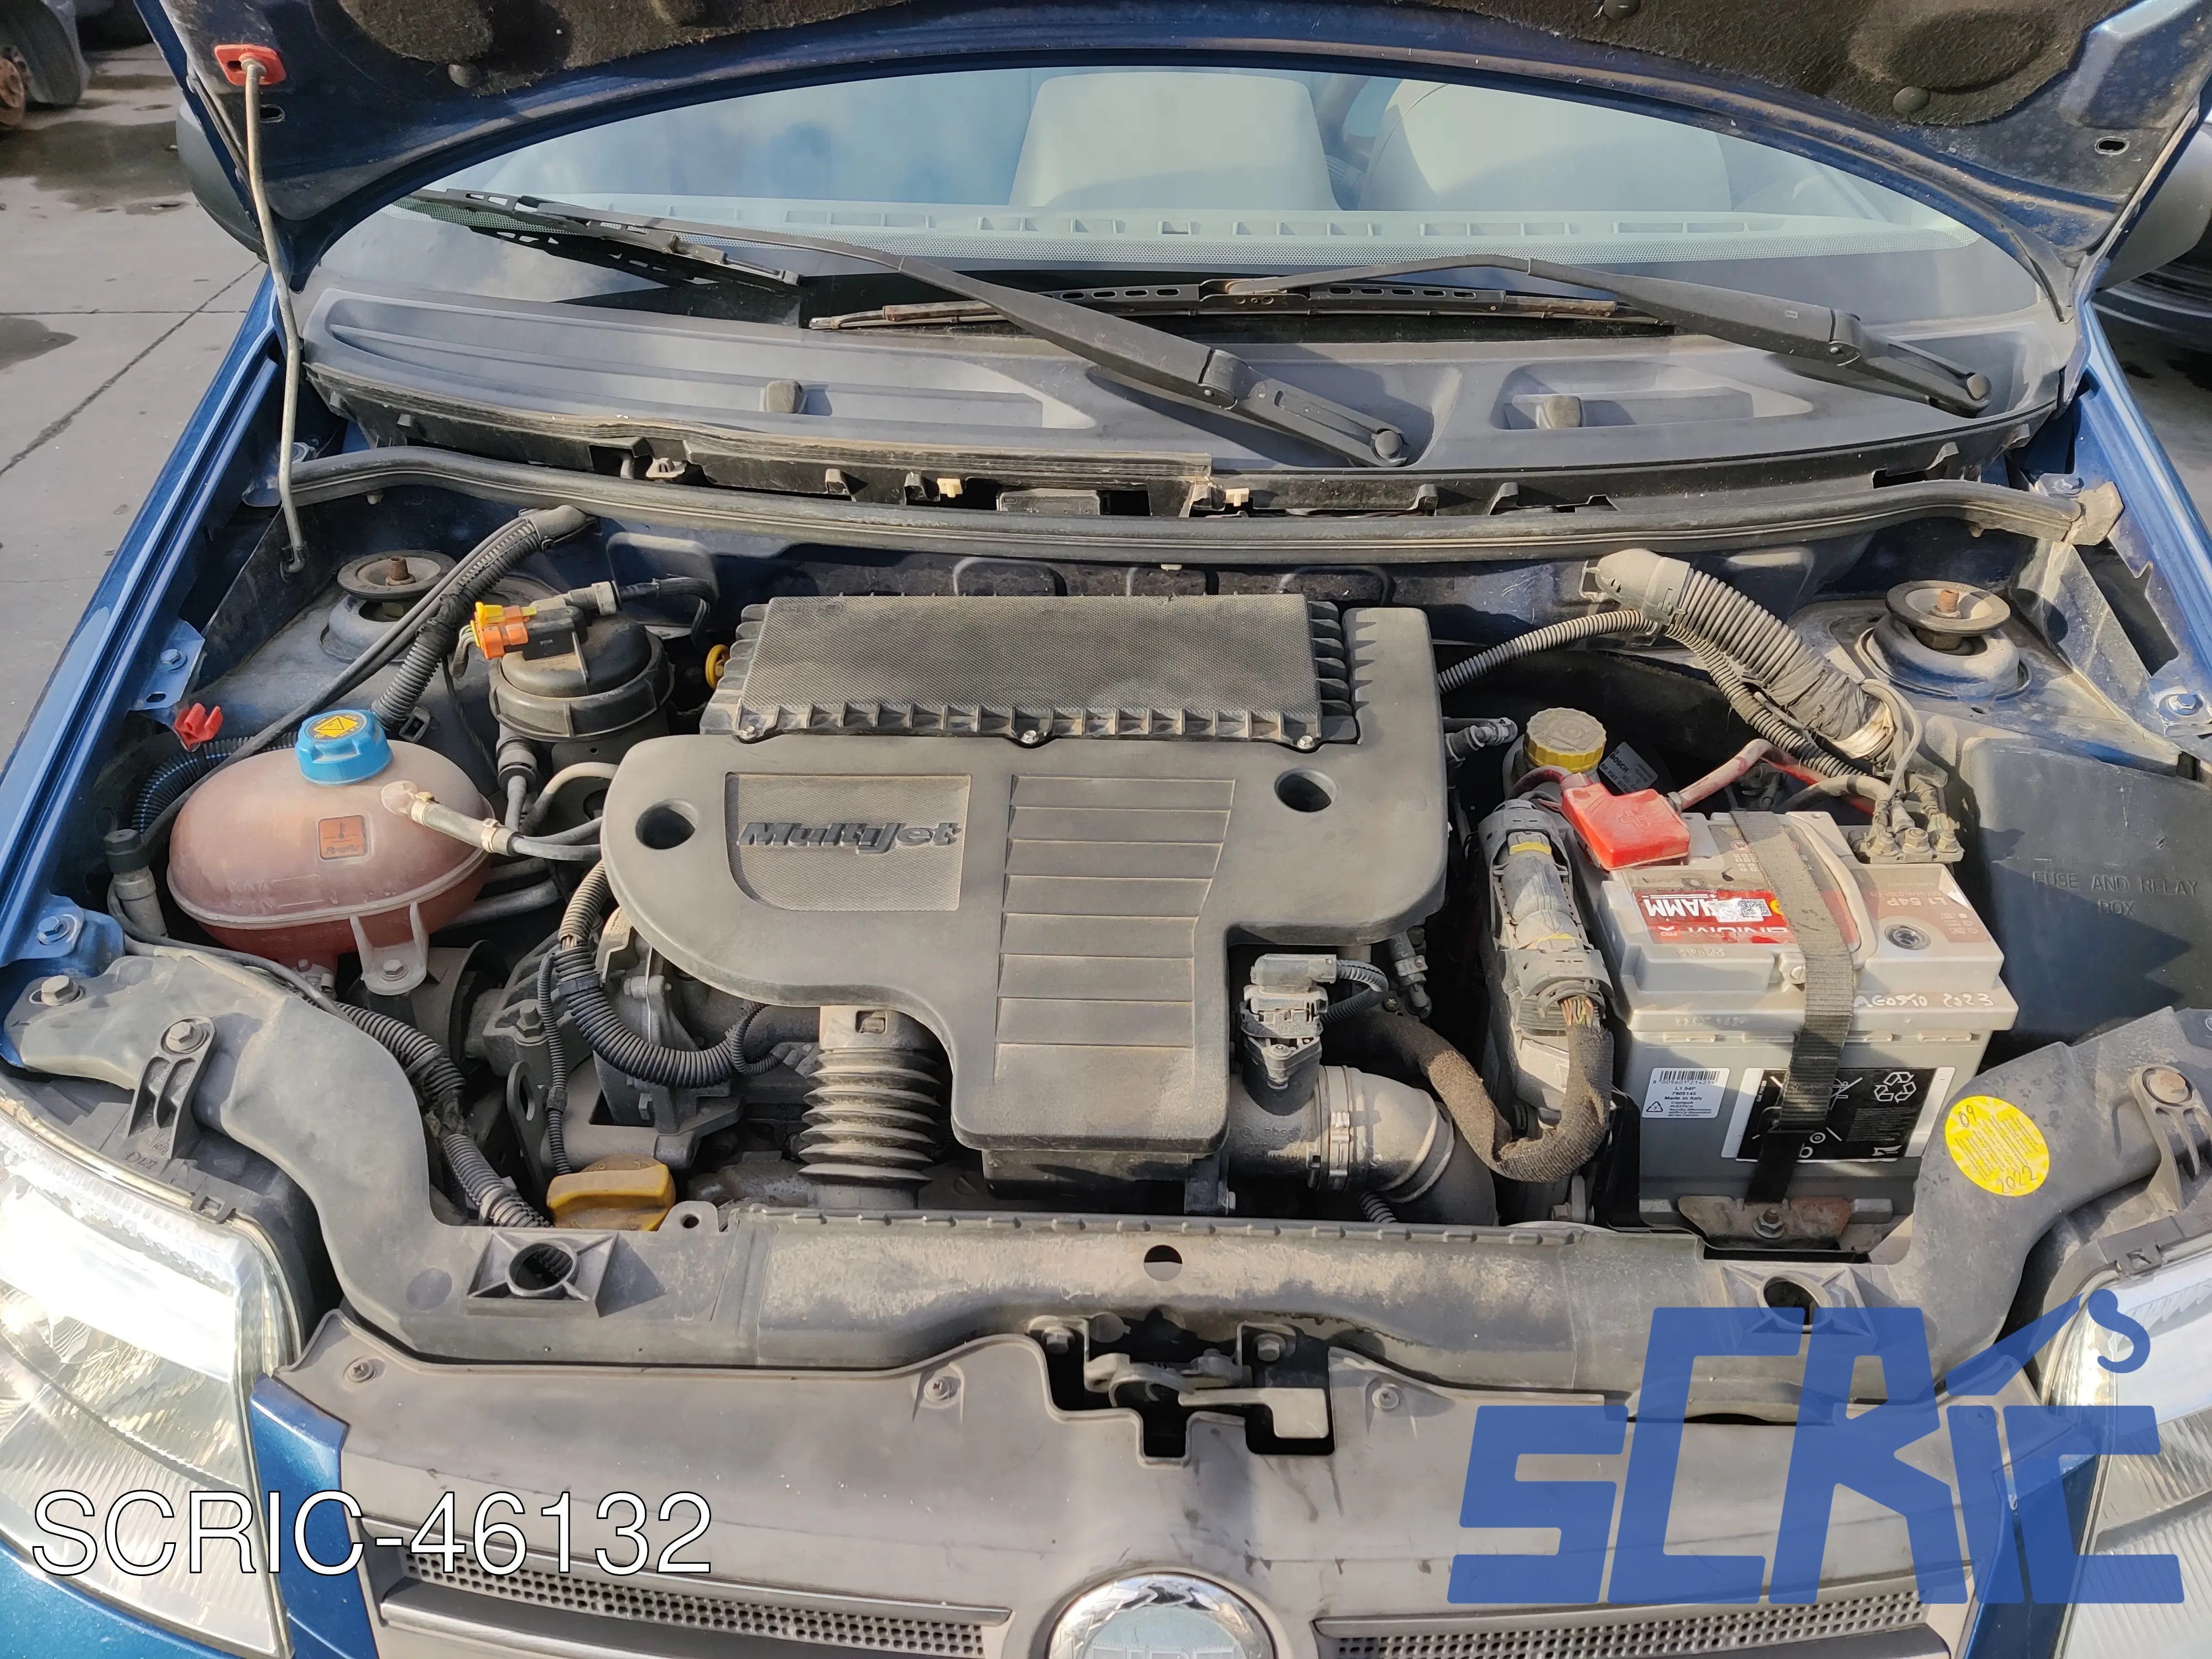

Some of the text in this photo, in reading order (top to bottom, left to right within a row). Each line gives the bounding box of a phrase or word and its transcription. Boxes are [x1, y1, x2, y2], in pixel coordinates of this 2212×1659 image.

[1609, 753, 1629, 773] BOSCH
[1608, 770, 1618, 780] FIAT
[228, 878, 270, 893] MAX
[2032, 871, 2198, 895] FUSE AND RELAY
[233, 898, 275, 914] MIN
[1642, 899, 1717, 916] IAMM
[1886, 897, 1948, 906] L1 54P
[2098, 900, 2137, 916] BOX
[1943, 993, 1994, 1008] 2023
[1958, 1104, 1977, 1128] 09
[1996, 1165, 2038, 1194] 2022
